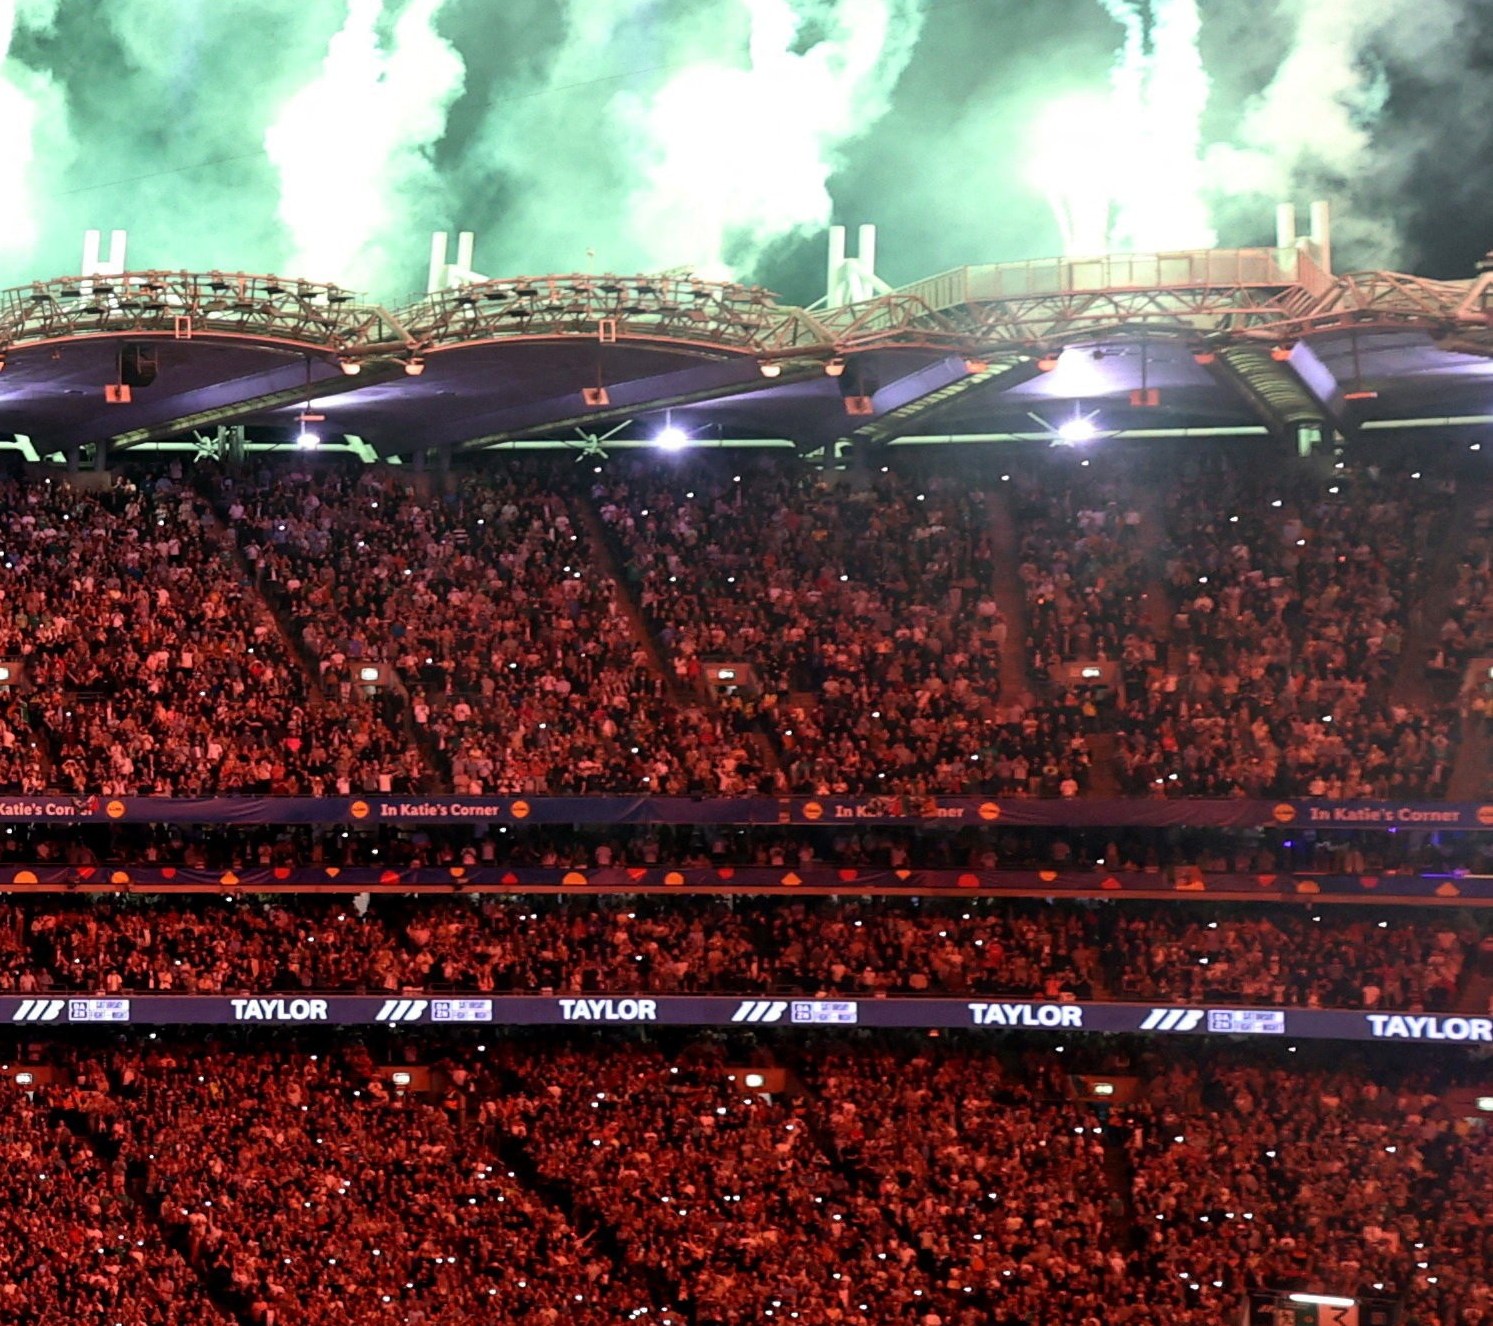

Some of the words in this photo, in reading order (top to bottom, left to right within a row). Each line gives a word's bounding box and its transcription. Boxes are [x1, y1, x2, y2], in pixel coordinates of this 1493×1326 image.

[381, 804, 397, 816] In
[401, 803, 447, 815] Katie's
[451, 804, 498, 815] Corner
[835, 805, 852, 817] In
[1310, 808, 1330, 820] In
[1335, 808, 1393, 821] Katie's
[1398, 808, 1460, 821] Corner
[231, 999, 327, 1019] TAYLOR
[559, 999, 656, 1019] TAYLOR
[969, 1004, 1082, 1026] TAYLOR
[1366, 1014, 1493, 1040] TAYLOR
